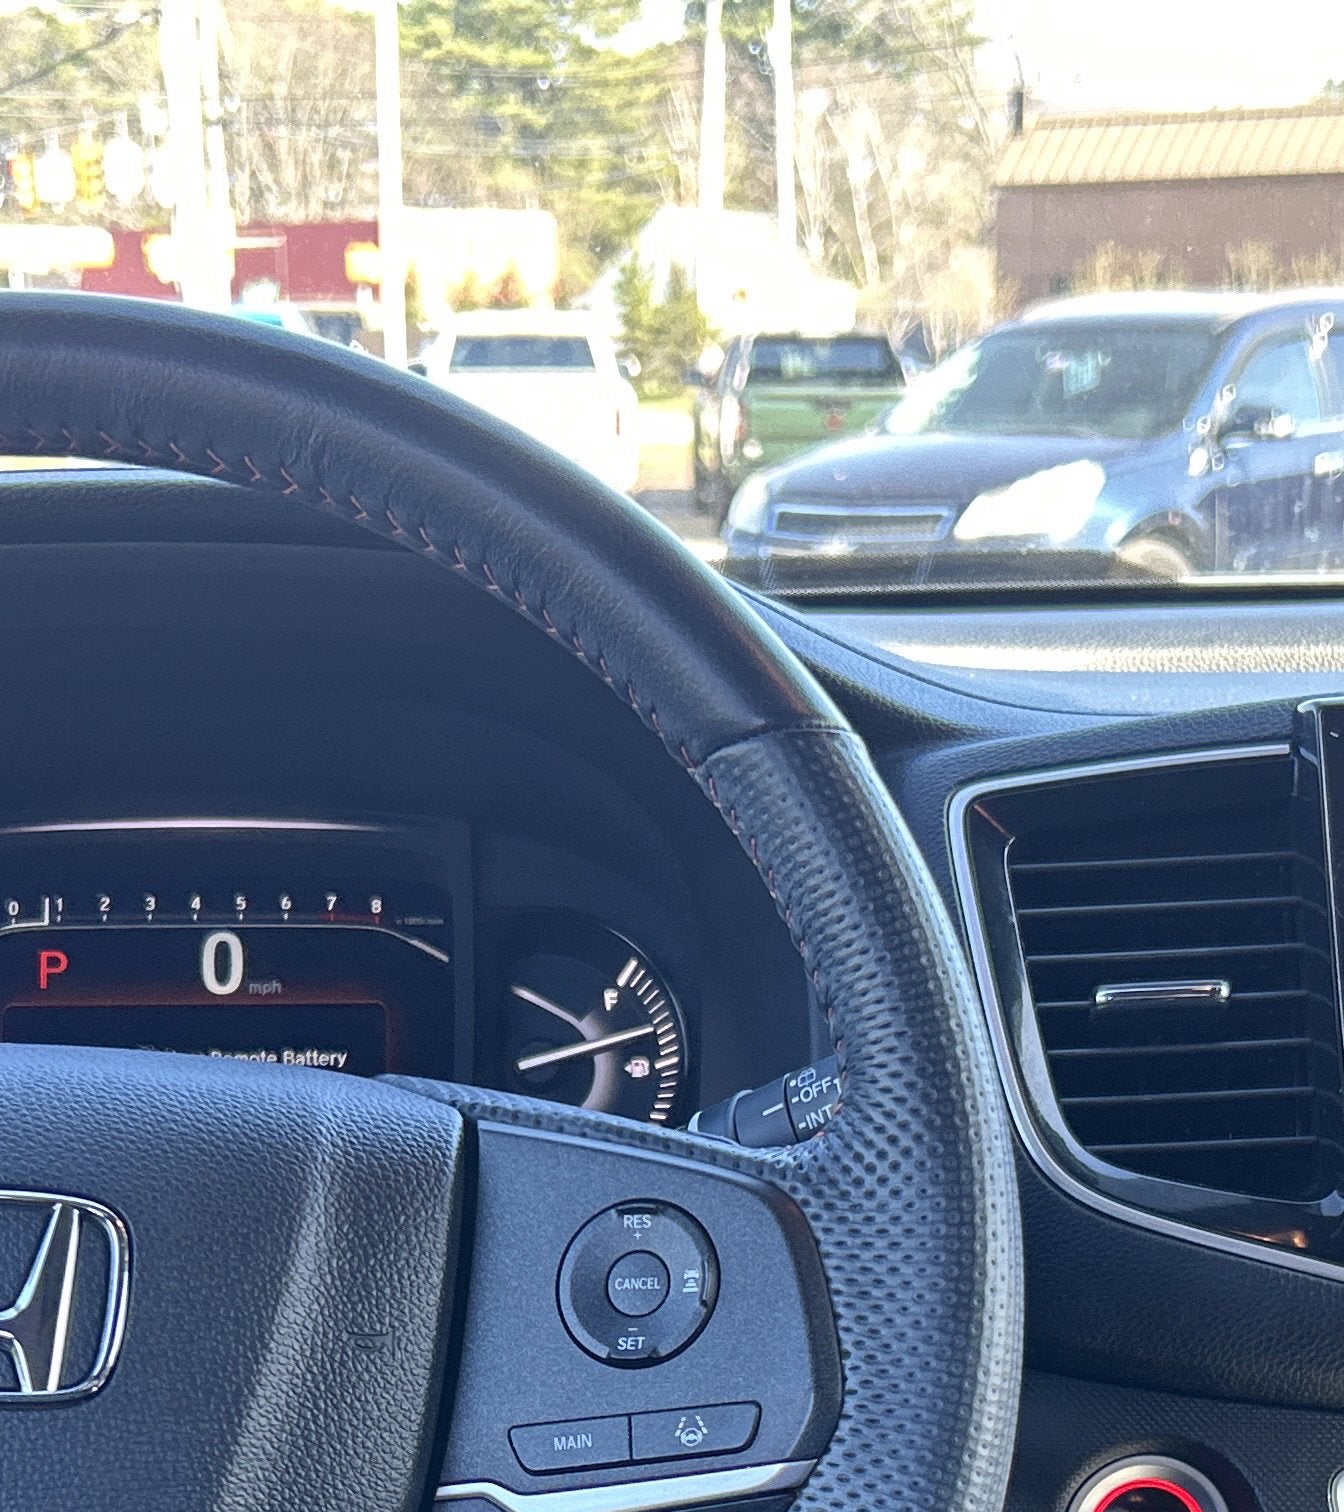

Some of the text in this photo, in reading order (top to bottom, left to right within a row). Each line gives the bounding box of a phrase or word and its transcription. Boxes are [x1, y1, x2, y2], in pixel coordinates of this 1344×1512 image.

[39, 950, 70, 989] P
[202, 932, 282, 995] 0 mph
[603, 989, 619, 1011] F
[283, 1050, 348, 1067] Battery
[799, 1076, 833, 1103] OFF
[805, 1103, 833, 1130] INT
[623, 1213, 652, 1229] RES
[614, 1277, 661, 1291] CANCEL
[617, 1336, 645, 1351] SET
[553, 1433, 593, 1451] MAIN
